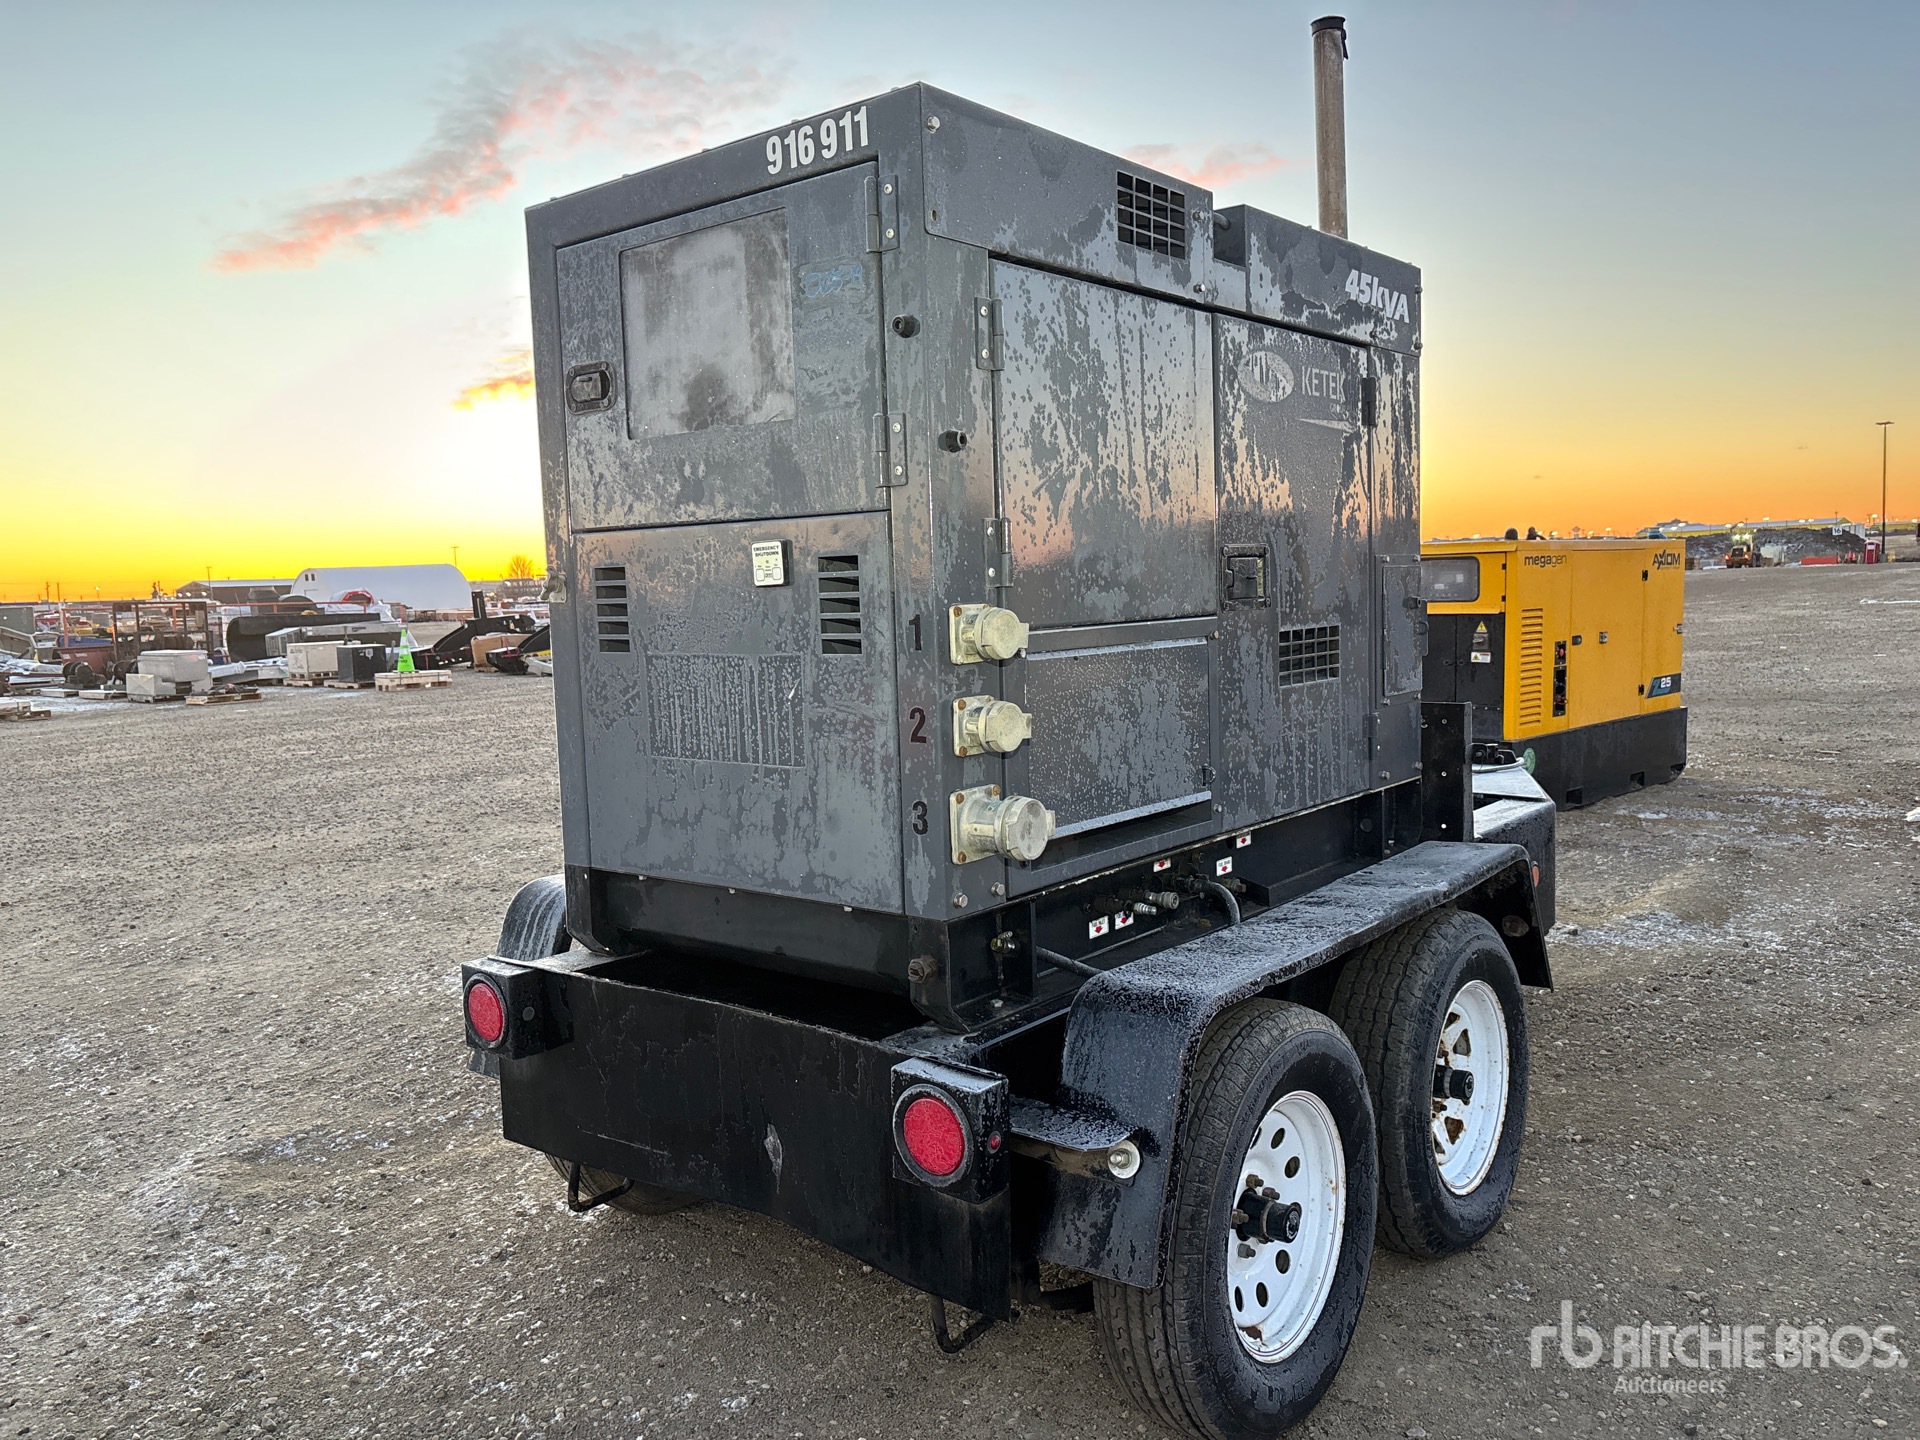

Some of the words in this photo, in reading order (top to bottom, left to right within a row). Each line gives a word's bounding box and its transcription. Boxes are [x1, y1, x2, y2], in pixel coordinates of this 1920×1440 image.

[765, 125, 815, 175] 916
[820, 105, 869, 159] 911
[1345, 269, 1410, 324] 45kVA
[1302, 366, 1347, 402] KETEK
[1833, 526, 1842, 534] 16
[1524, 554, 1567, 568] megagen
[1652, 549, 1681, 570] AXIOM
[909, 614, 922, 650] 1
[1660, 676, 1672, 688] 25
[909, 707, 927, 743] 2
[912, 800, 929, 835] 3
